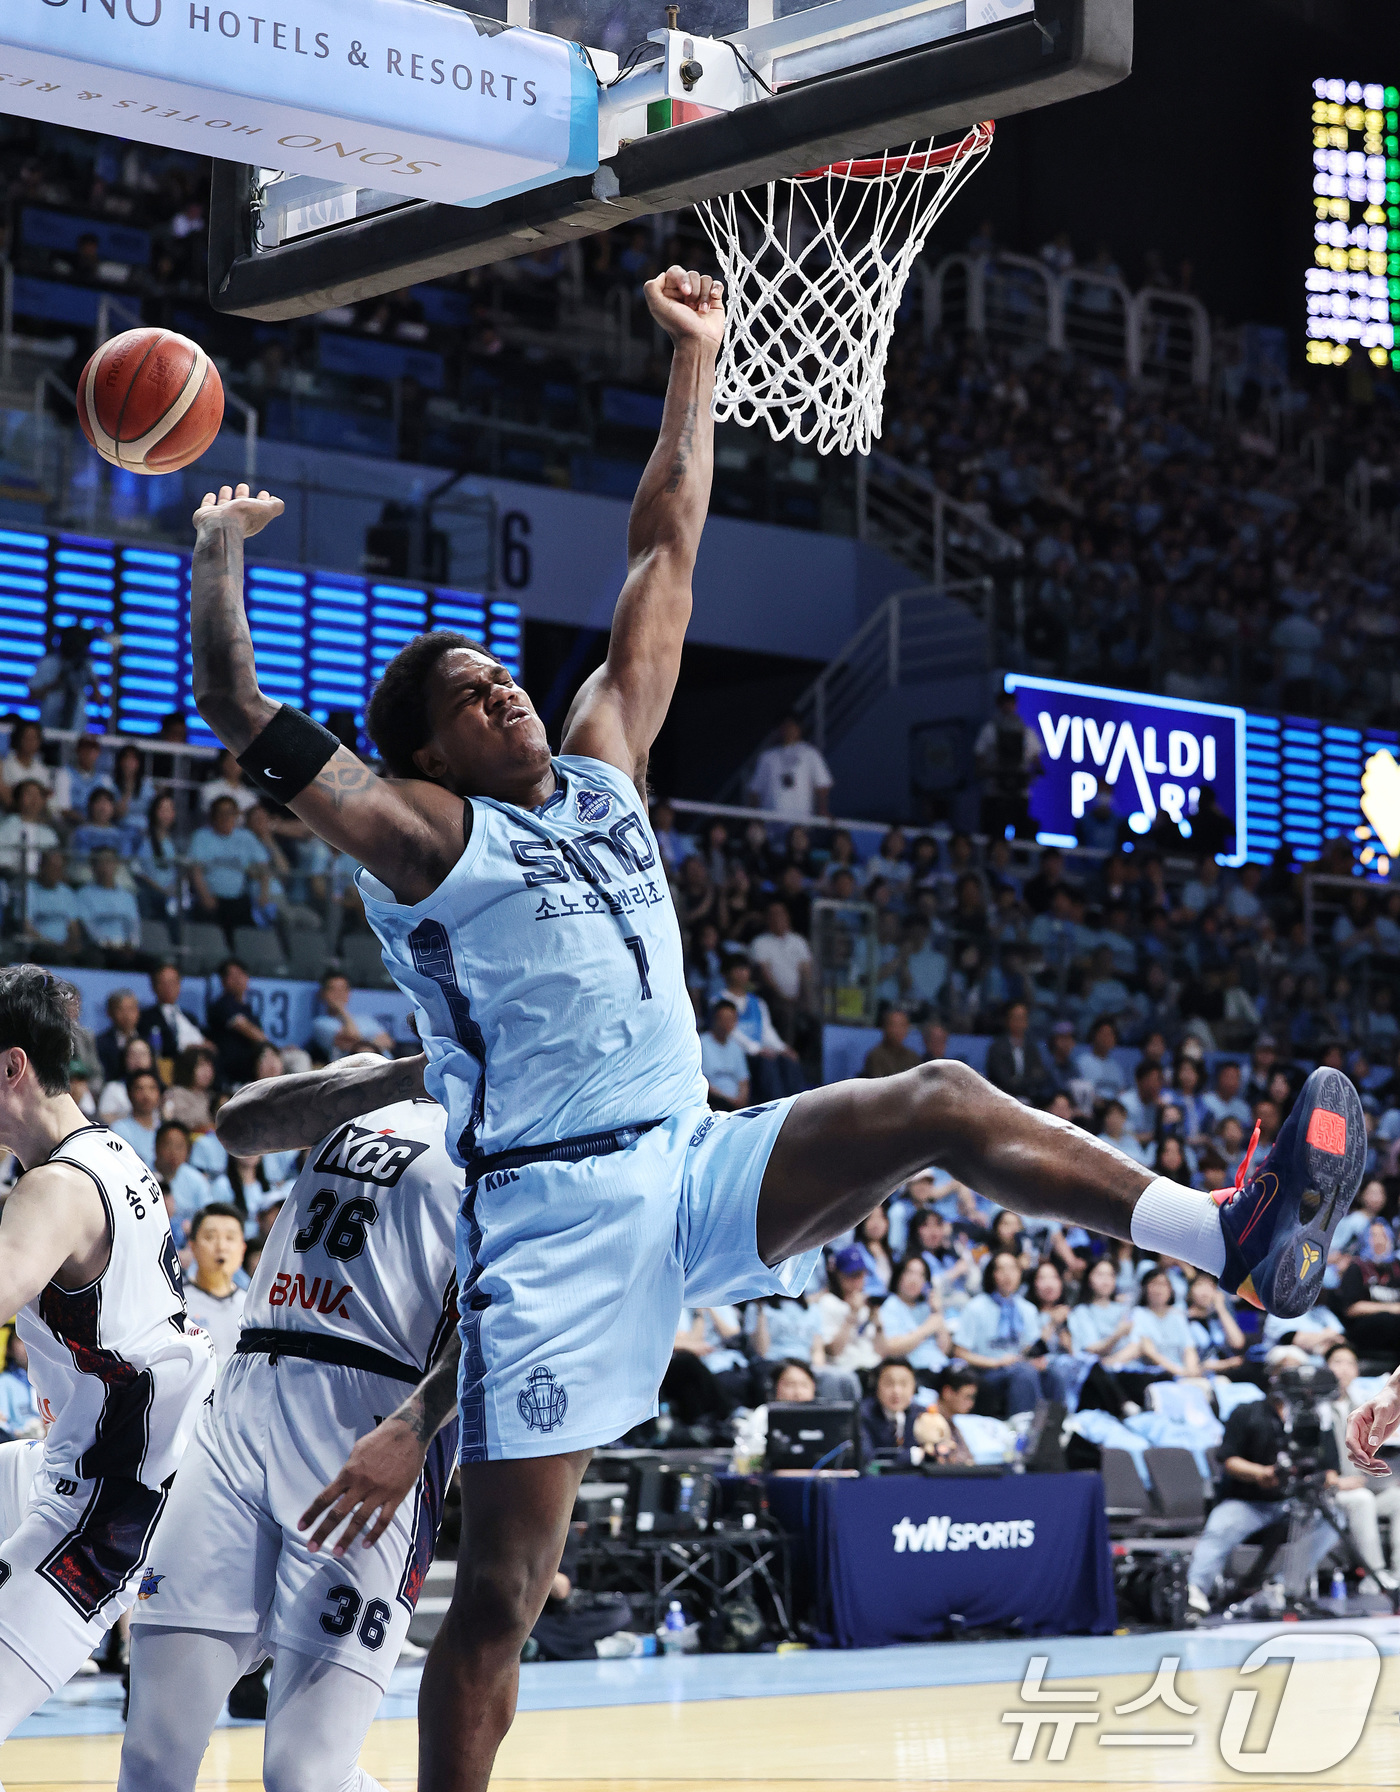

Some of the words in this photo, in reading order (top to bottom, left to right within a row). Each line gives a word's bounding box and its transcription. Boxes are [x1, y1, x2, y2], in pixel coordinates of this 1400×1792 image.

[190, 3, 330, 58] HOTELS
[347, 40, 370, 69] &
[387, 48, 537, 106] RESORTS
[112, 99, 263, 135] HOTELS
[277, 134, 442, 175] SONO
[502, 511, 531, 589] 6
[1038, 711, 1216, 790] VIVALDI
[624, 935, 652, 1001] 1
[324, 1129, 412, 1180] KCC
[293, 1188, 379, 1262] 36
[948, 1520, 1035, 1551] SPORTS
[319, 1584, 392, 1652] 36
